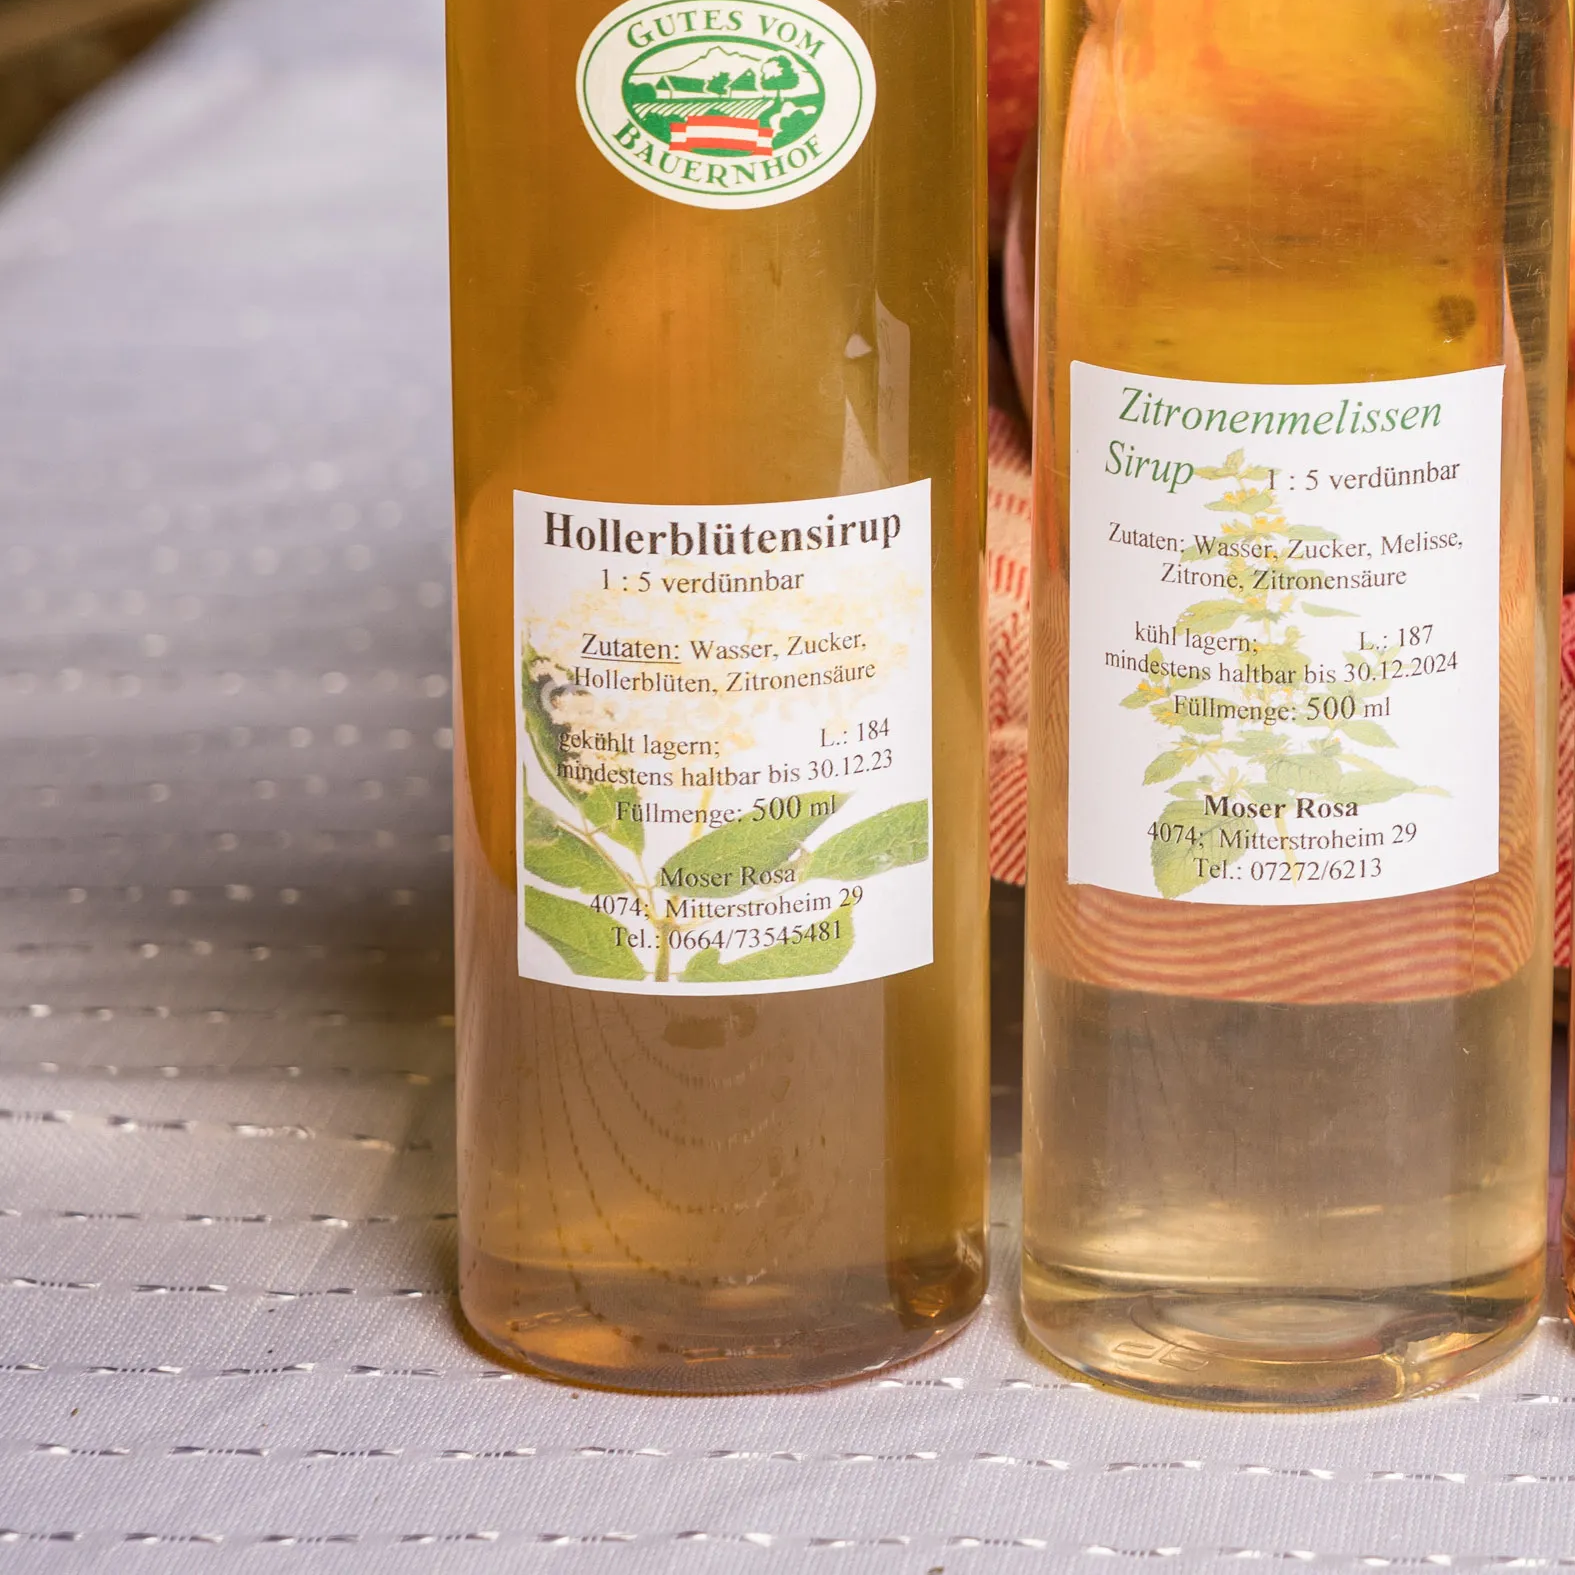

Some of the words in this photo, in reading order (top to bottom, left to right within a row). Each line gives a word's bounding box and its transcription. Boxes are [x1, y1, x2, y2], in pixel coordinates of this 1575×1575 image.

[627, 9, 743, 48] GUTES
[758, 13, 826, 60] VOM
[612, 118, 825, 188] BAUERNHOF
[1119, 386, 1442, 435] Zitronenmelissen
[1105, 439, 1195, 495] Sirup
[1268, 469, 1276, 490] 1
[1306, 469, 1318, 490] 5
[1329, 461, 1461, 489] verdünnbar
[544, 511, 901, 556] Hollerblütensirup
[1108, 521, 1185, 553] Zutaten:
[1194, 534, 1277, 561] Wasser,
[1287, 538, 1372, 560] Zucker,
[1380, 530, 1463, 556] Melisse,
[602, 569, 609, 590] 1
[639, 571, 651, 592] 5
[661, 570, 804, 594] verdünnbar
[1160, 562, 1243, 591] Zitrone,
[1252, 567, 1407, 591] Zitronensäure
[581, 633, 680, 660] Zutaten:
[691, 640, 778, 661] Wasser,
[787, 632, 866, 657] Zucker,
[1135, 620, 1176, 646] kühl
[1185, 623, 1258, 654] lagern;
[1359, 631, 1388, 652] L.:
[1399, 624, 1434, 647] 187
[573, 667, 717, 694] Hollerblüten,
[726, 661, 875, 693] Zitronensäure
[1105, 649, 1211, 681] mindestens
[1218, 664, 1297, 684] haltbar
[1304, 663, 1336, 684] bis
[1343, 651, 1458, 683] 30.12.2024
[1174, 695, 1297, 725] Füllmenge:
[1306, 695, 1355, 720] 500
[1363, 697, 1390, 718] ml
[559, 733, 634, 754] gekühlt
[644, 735, 719, 760] lagern;
[820, 728, 847, 748] L.:
[857, 718, 890, 742] 184
[556, 762, 674, 787] mindestens
[680, 766, 761, 786] haltbar
[768, 763, 801, 784] bis
[808, 749, 893, 781] 30.12.23
[616, 801, 742, 827] Füllmenge:
[752, 796, 802, 820] 500
[809, 795, 836, 817] ml
[1204, 794, 1285, 818] Moser
[1296, 797, 1359, 819] Rosa
[1147, 822, 1204, 849] 4074;
[1219, 826, 1384, 850] Mitterstroheim
[1392, 823, 1417, 844] 29
[660, 865, 732, 888] Moser
[740, 865, 796, 885] Rosa
[1192, 856, 1242, 880] Tel.:
[1250, 857, 1382, 882] 07272/6213
[590, 895, 650, 918] 4074;
[666, 896, 832, 919] Mitterstroheim
[839, 886, 864, 907] 29
[611, 926, 660, 949] Tel.:
[668, 921, 842, 949] 0664/73545481
